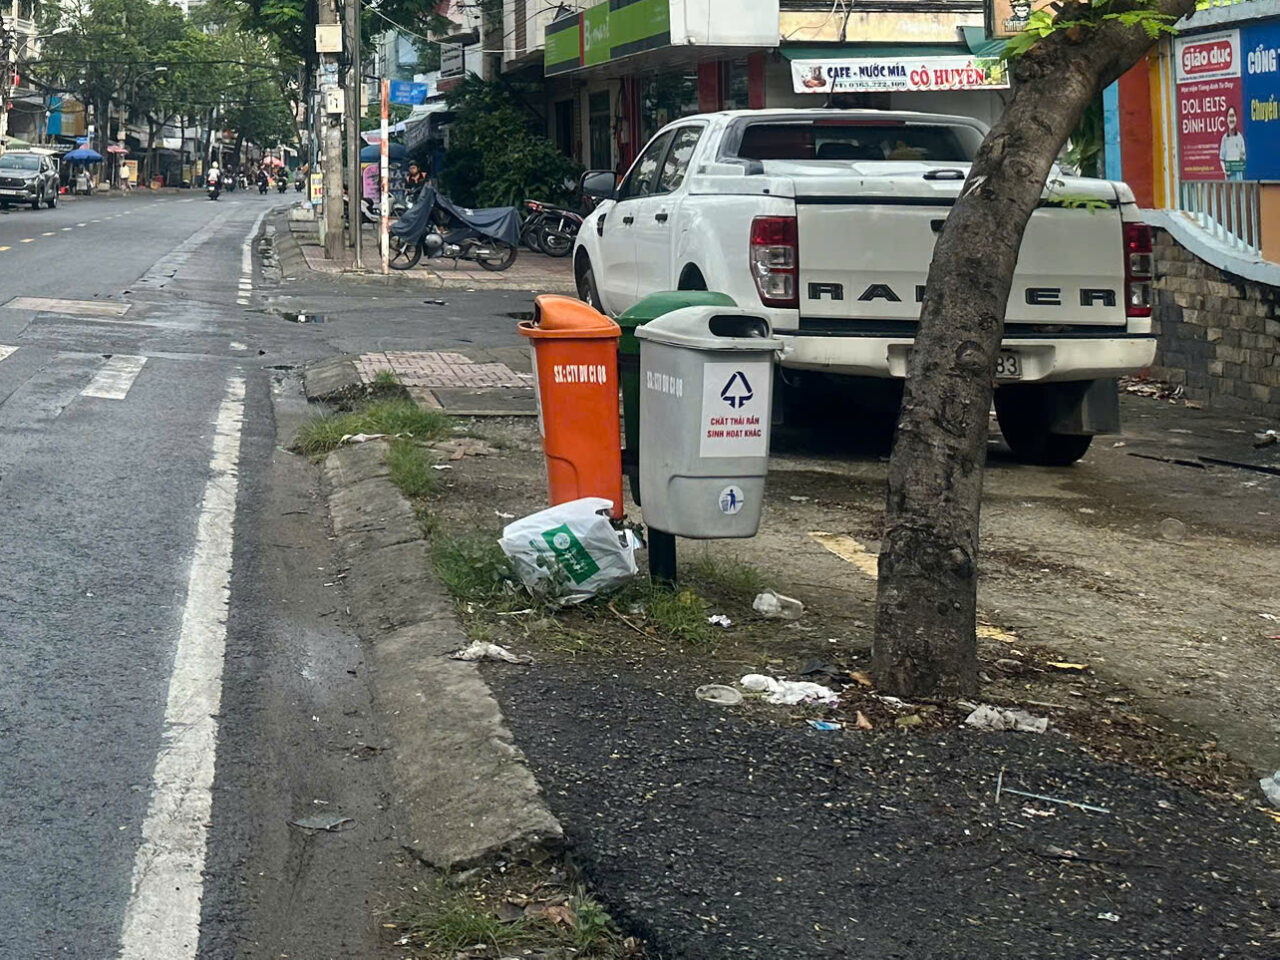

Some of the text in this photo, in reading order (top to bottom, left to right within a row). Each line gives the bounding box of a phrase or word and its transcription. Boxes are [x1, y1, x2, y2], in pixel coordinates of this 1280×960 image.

[1184, 46, 1231, 71] giáo dục
[1247, 44, 1277, 74] CỔNG
[827, 66, 851, 79] CAFE
[859, 62, 886, 78] NƯỚC
[887, 62, 907, 77] MÍA
[910, 64, 931, 86] CÔ
[933, 60, 986, 86] HUYỀN
[1182, 96, 1227, 114] DOL IELTS
[1183, 115, 1226, 135] ĐÌNH LỰC
[808, 282, 1116, 307] RAER
[597, 365, 606, 385] Q8
[729, 415, 744, 425] THẢI
[745, 414, 760, 425] RẮN
[707, 430, 724, 438] SINH
[744, 428, 762, 437] KHÁC
